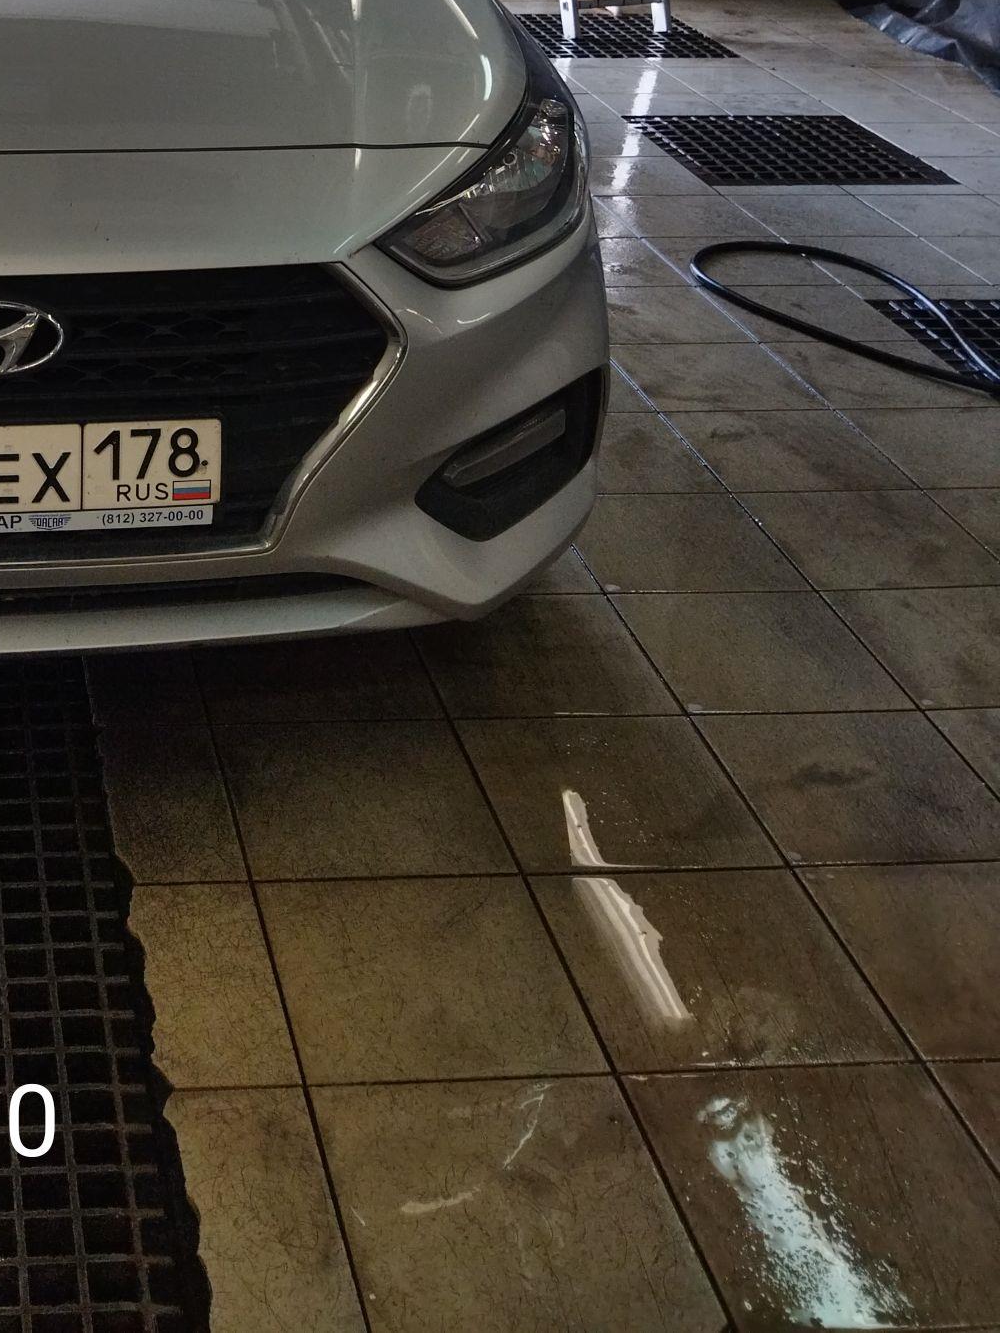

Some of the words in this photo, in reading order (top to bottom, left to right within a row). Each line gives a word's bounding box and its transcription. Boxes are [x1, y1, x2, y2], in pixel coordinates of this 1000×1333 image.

[93, 427, 200, 481] 178
[116, 483, 169, 503] RUS
[102, 512, 135, 526] (812)
[139, 510, 204, 523] 327-00-00
